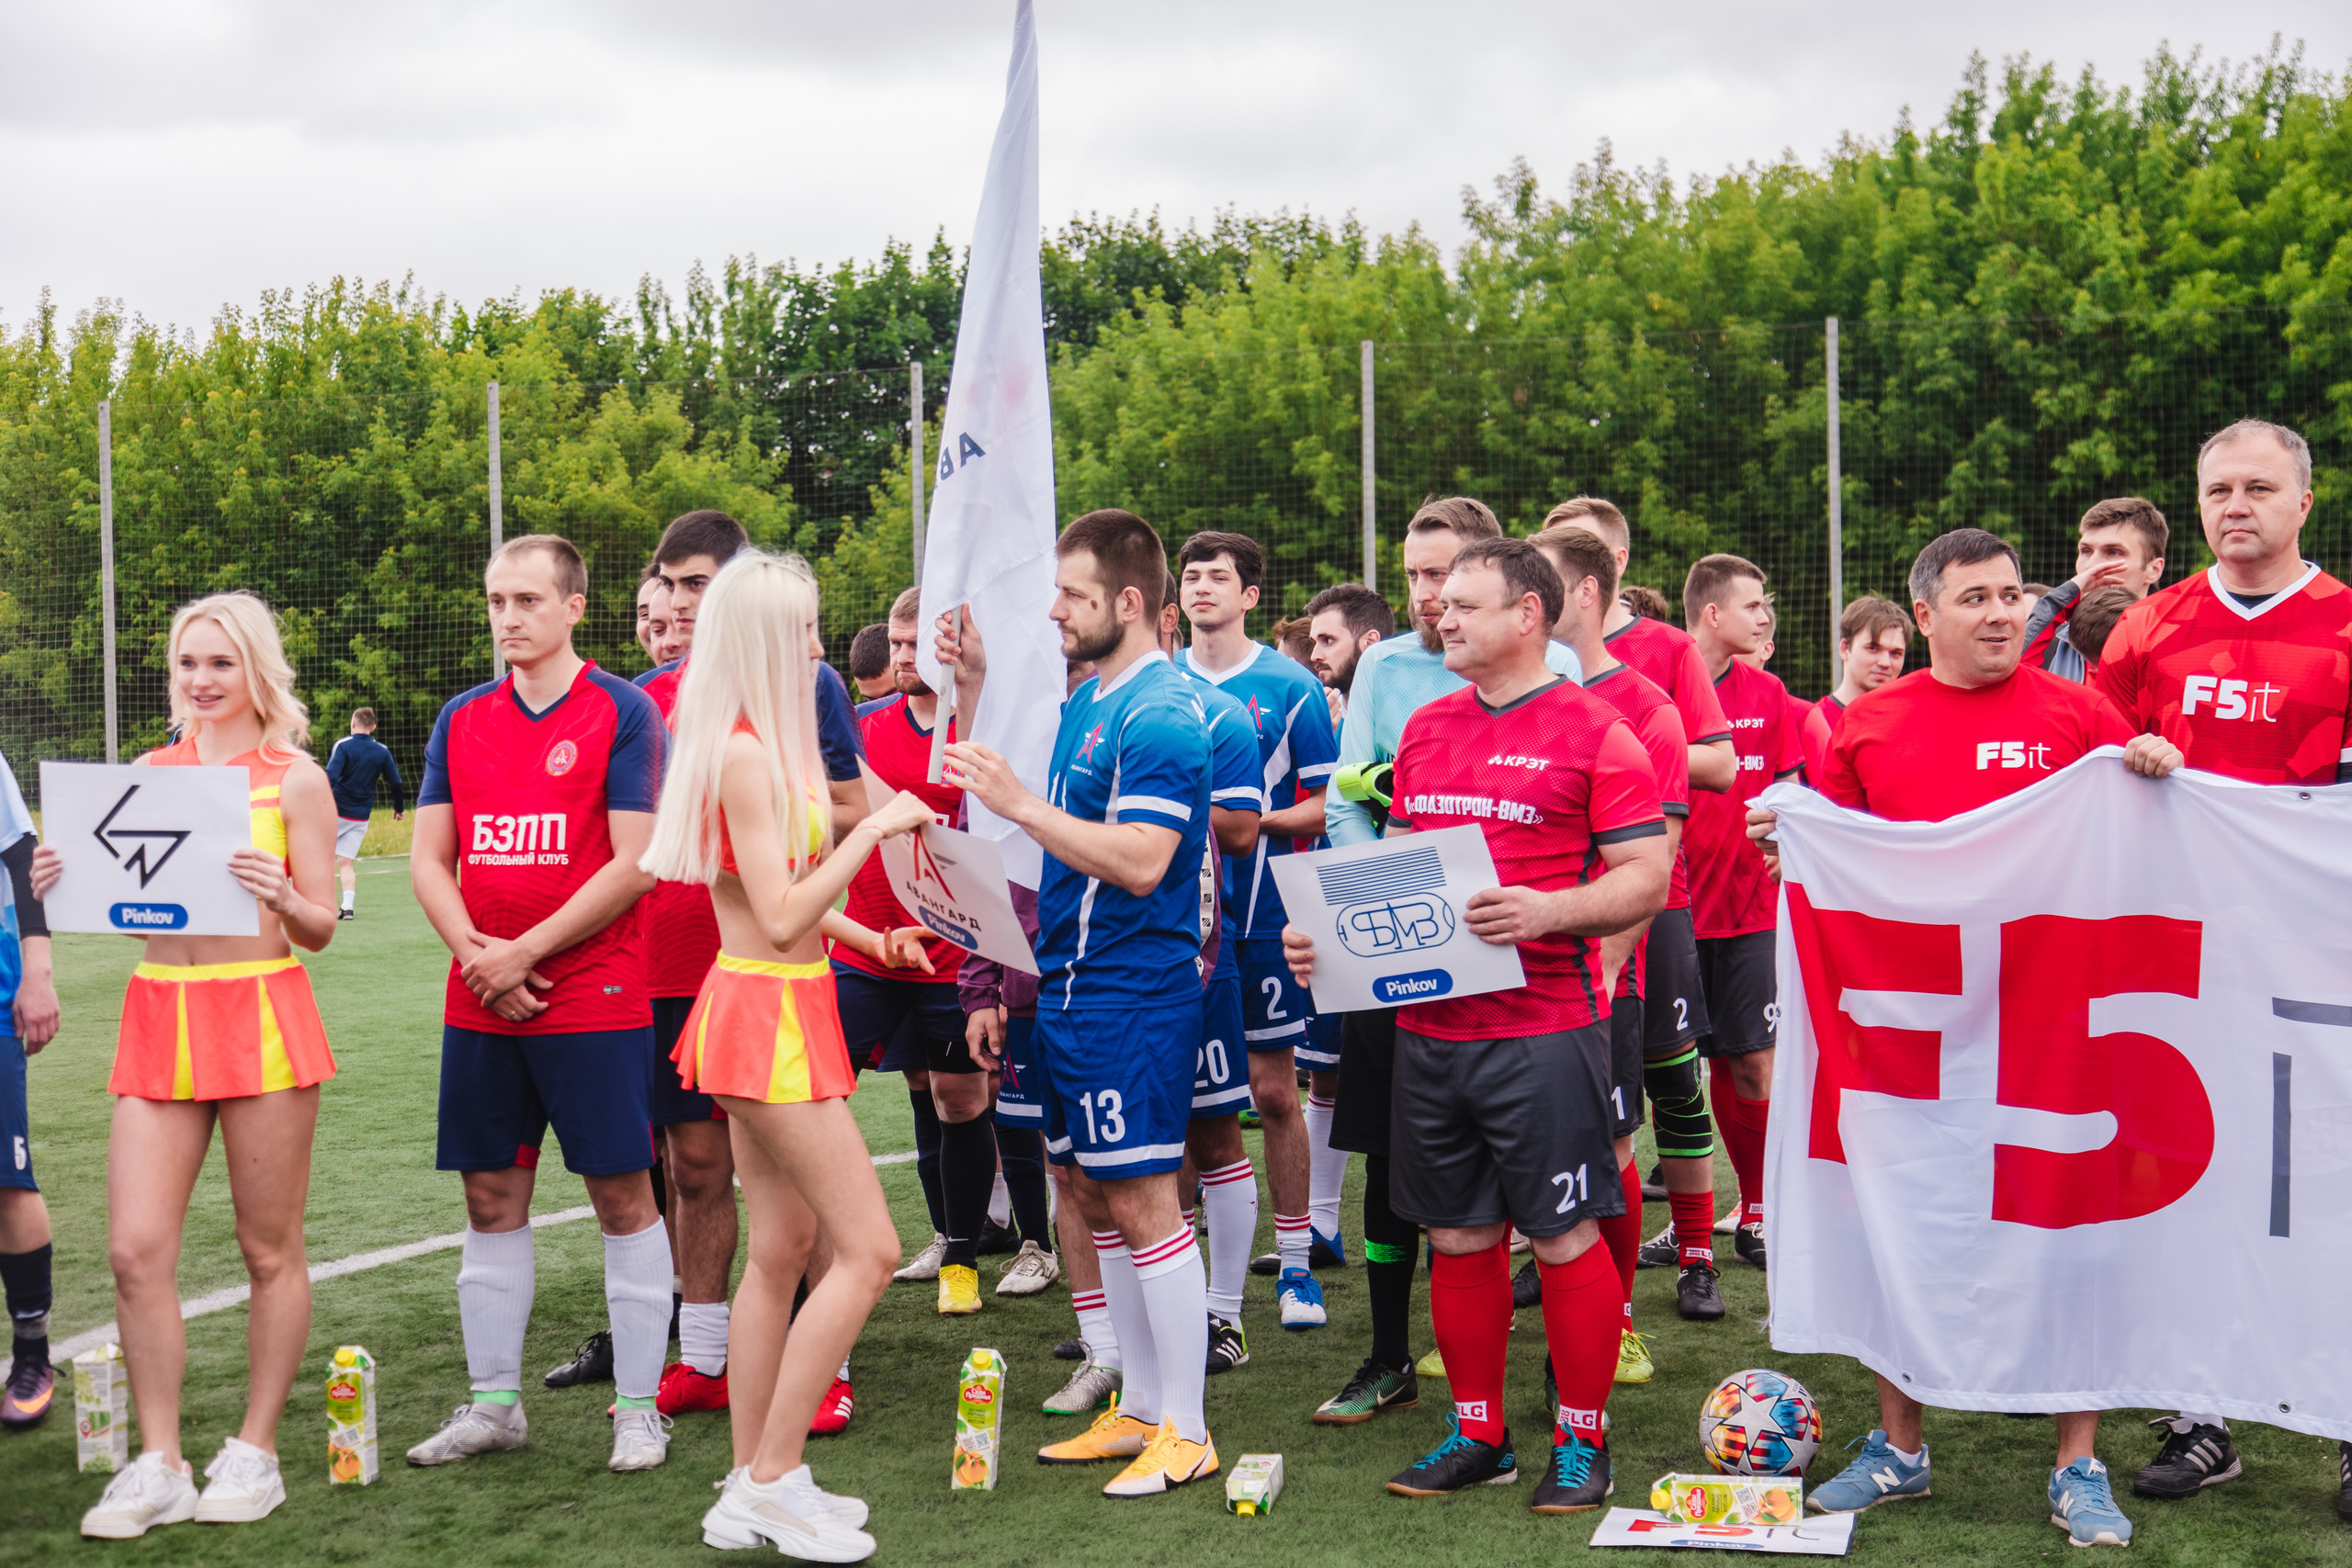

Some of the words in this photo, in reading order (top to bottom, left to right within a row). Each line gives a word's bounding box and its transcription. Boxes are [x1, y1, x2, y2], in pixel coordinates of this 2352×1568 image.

[2182, 675, 2281, 723] F5it
[1736, 717, 1765, 729] КРЭТ
[1503, 755, 1550, 772] КРЭТ
[1976, 741, 2052, 770] F5it
[472, 813, 567, 852] БЗПП
[468, 852, 536, 865] ФУТБОЛЬНЫЙ
[537, 853, 569, 864] КЛУБ
[121, 907, 175, 925] Pinkov
[907, 881, 982, 932] АВАНГАРД
[926, 913, 966, 942] Pinkov
[1261, 976, 1287, 1021] 2
[1385, 978, 1438, 997] Pinkov
[1673, 998, 1689, 1032] 2
[1763, 1002, 1777, 1033] 9
[1080, 1089, 1126, 1145] 13
[1552, 1163, 1589, 1215] 21
[1687, 1540, 1747, 1549] Pinkov
